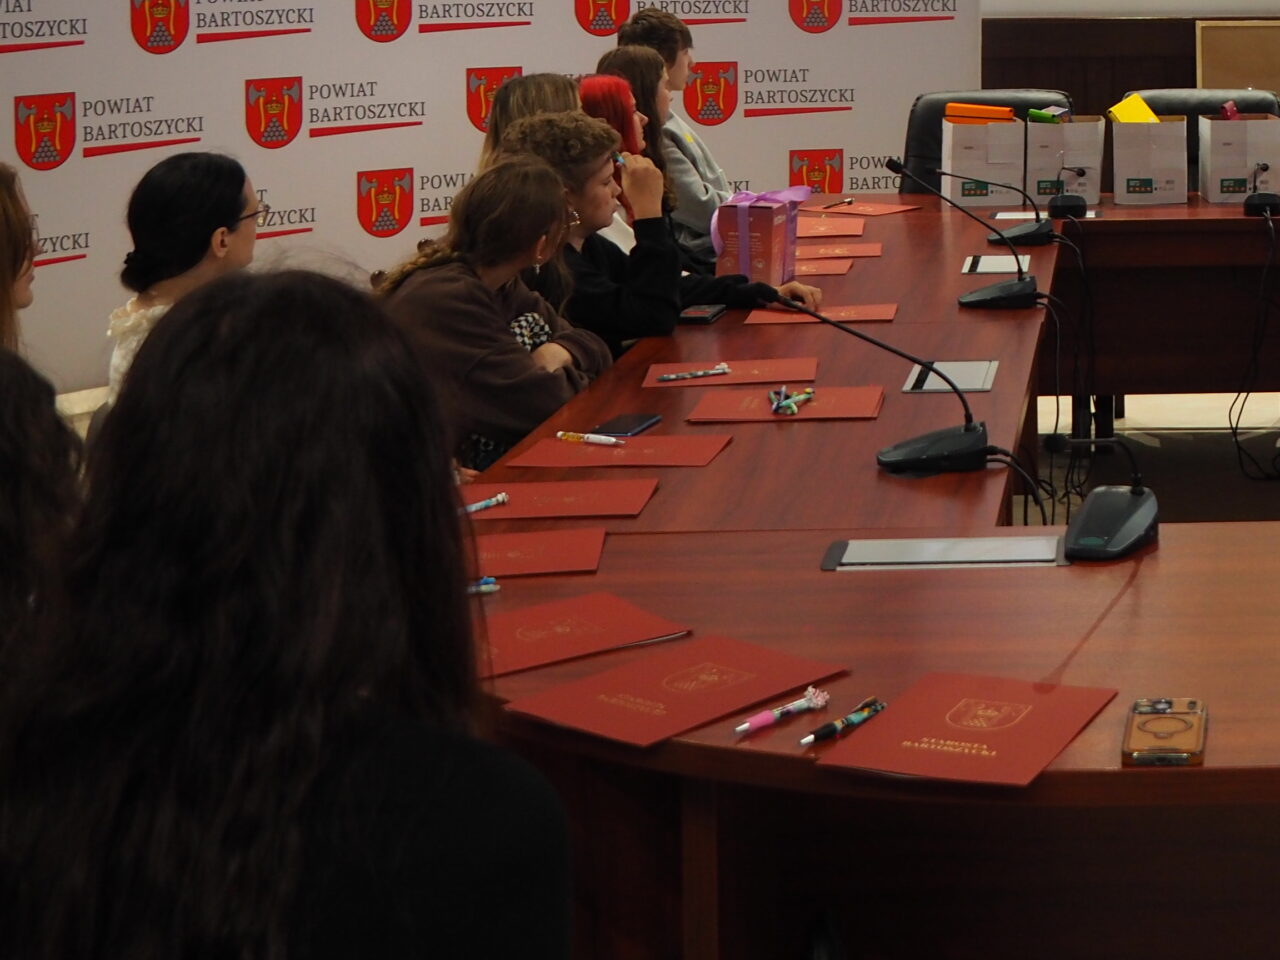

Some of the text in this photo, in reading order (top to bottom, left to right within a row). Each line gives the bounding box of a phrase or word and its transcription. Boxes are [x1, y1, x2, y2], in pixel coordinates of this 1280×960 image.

[419, 3, 533, 18] BARTOSZYCKI
[849, 0, 956, 12] BARTOSZYCKI
[197, 8, 313, 28] BARTOSZYCKI
[745, 69, 808, 83] POWIAT
[309, 82, 377, 100] POWIAT
[745, 89, 854, 104] BARTOSZYCKI
[83, 97, 153, 117] POWIAT
[309, 102, 426, 123] BARTOSZYCKI
[83, 116, 203, 142] BARTOSZYCKI
